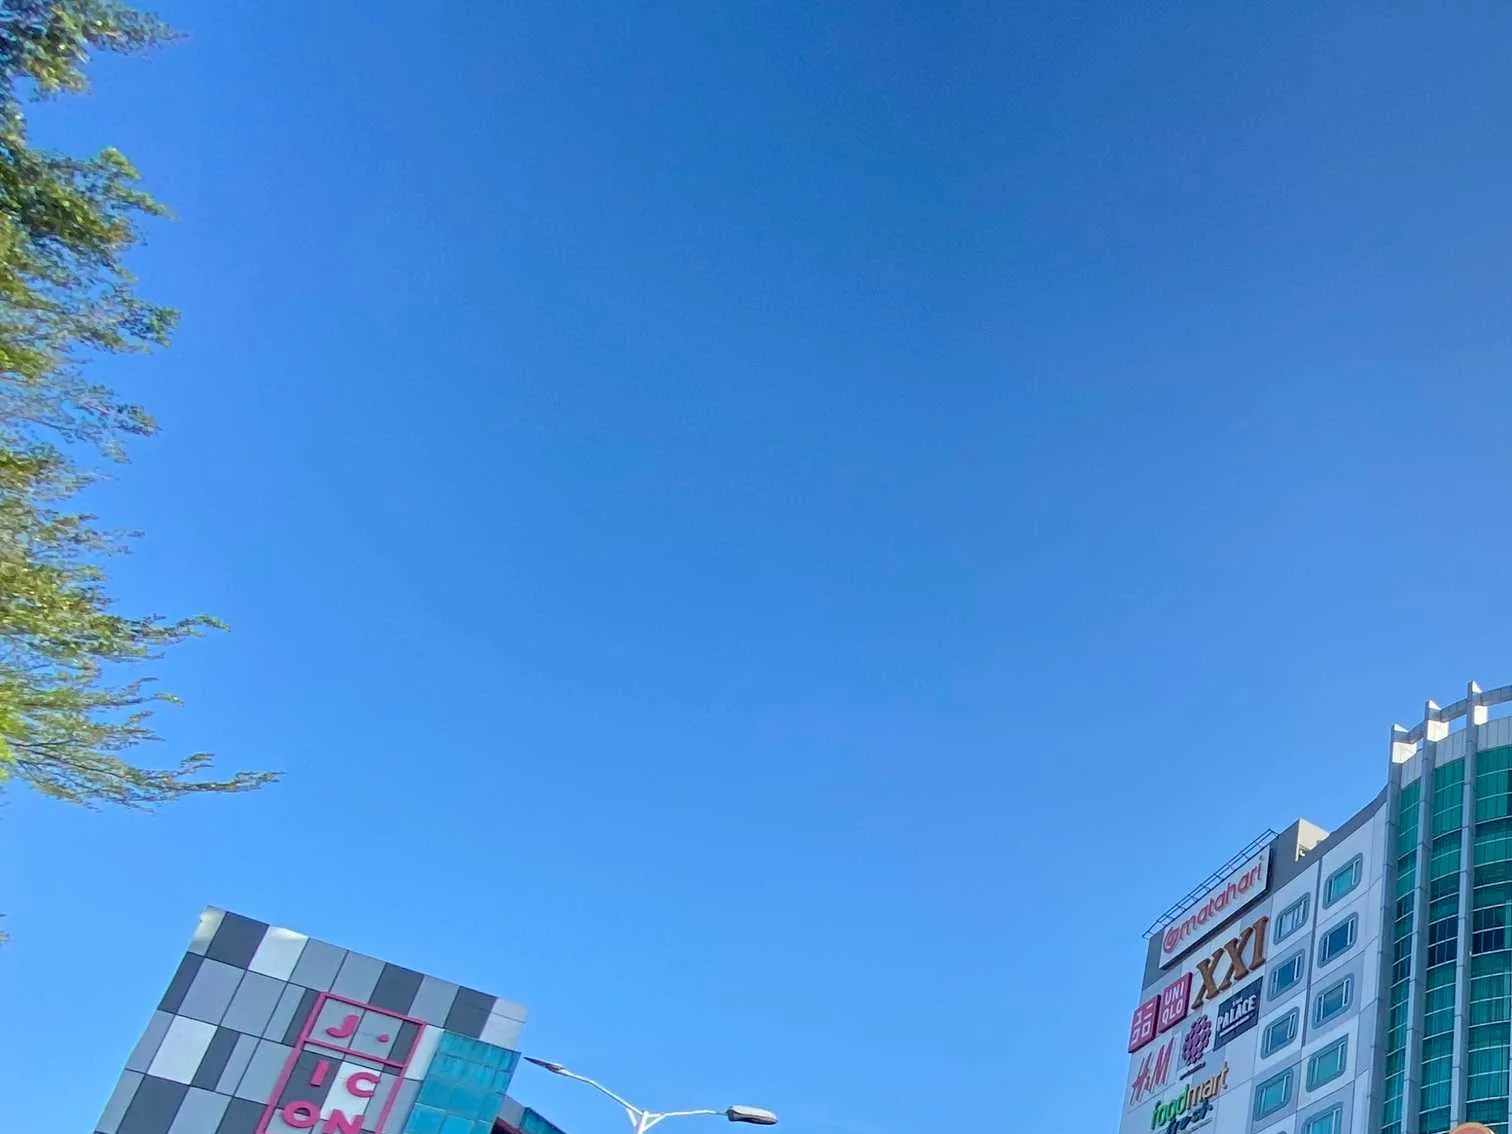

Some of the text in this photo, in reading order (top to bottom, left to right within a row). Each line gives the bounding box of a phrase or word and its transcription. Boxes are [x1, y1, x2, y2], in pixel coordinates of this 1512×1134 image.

[1180, 856, 1263, 941] matahari
[1164, 981, 1185, 1006] UNI
[1191, 916, 1269, 1010] XXI
[1161, 999, 1184, 1026] QLO
[1217, 994, 1257, 1033] PALACE
[1130, 1036, 1175, 1106] H&M
[1151, 1061, 1230, 1131] foodmart
